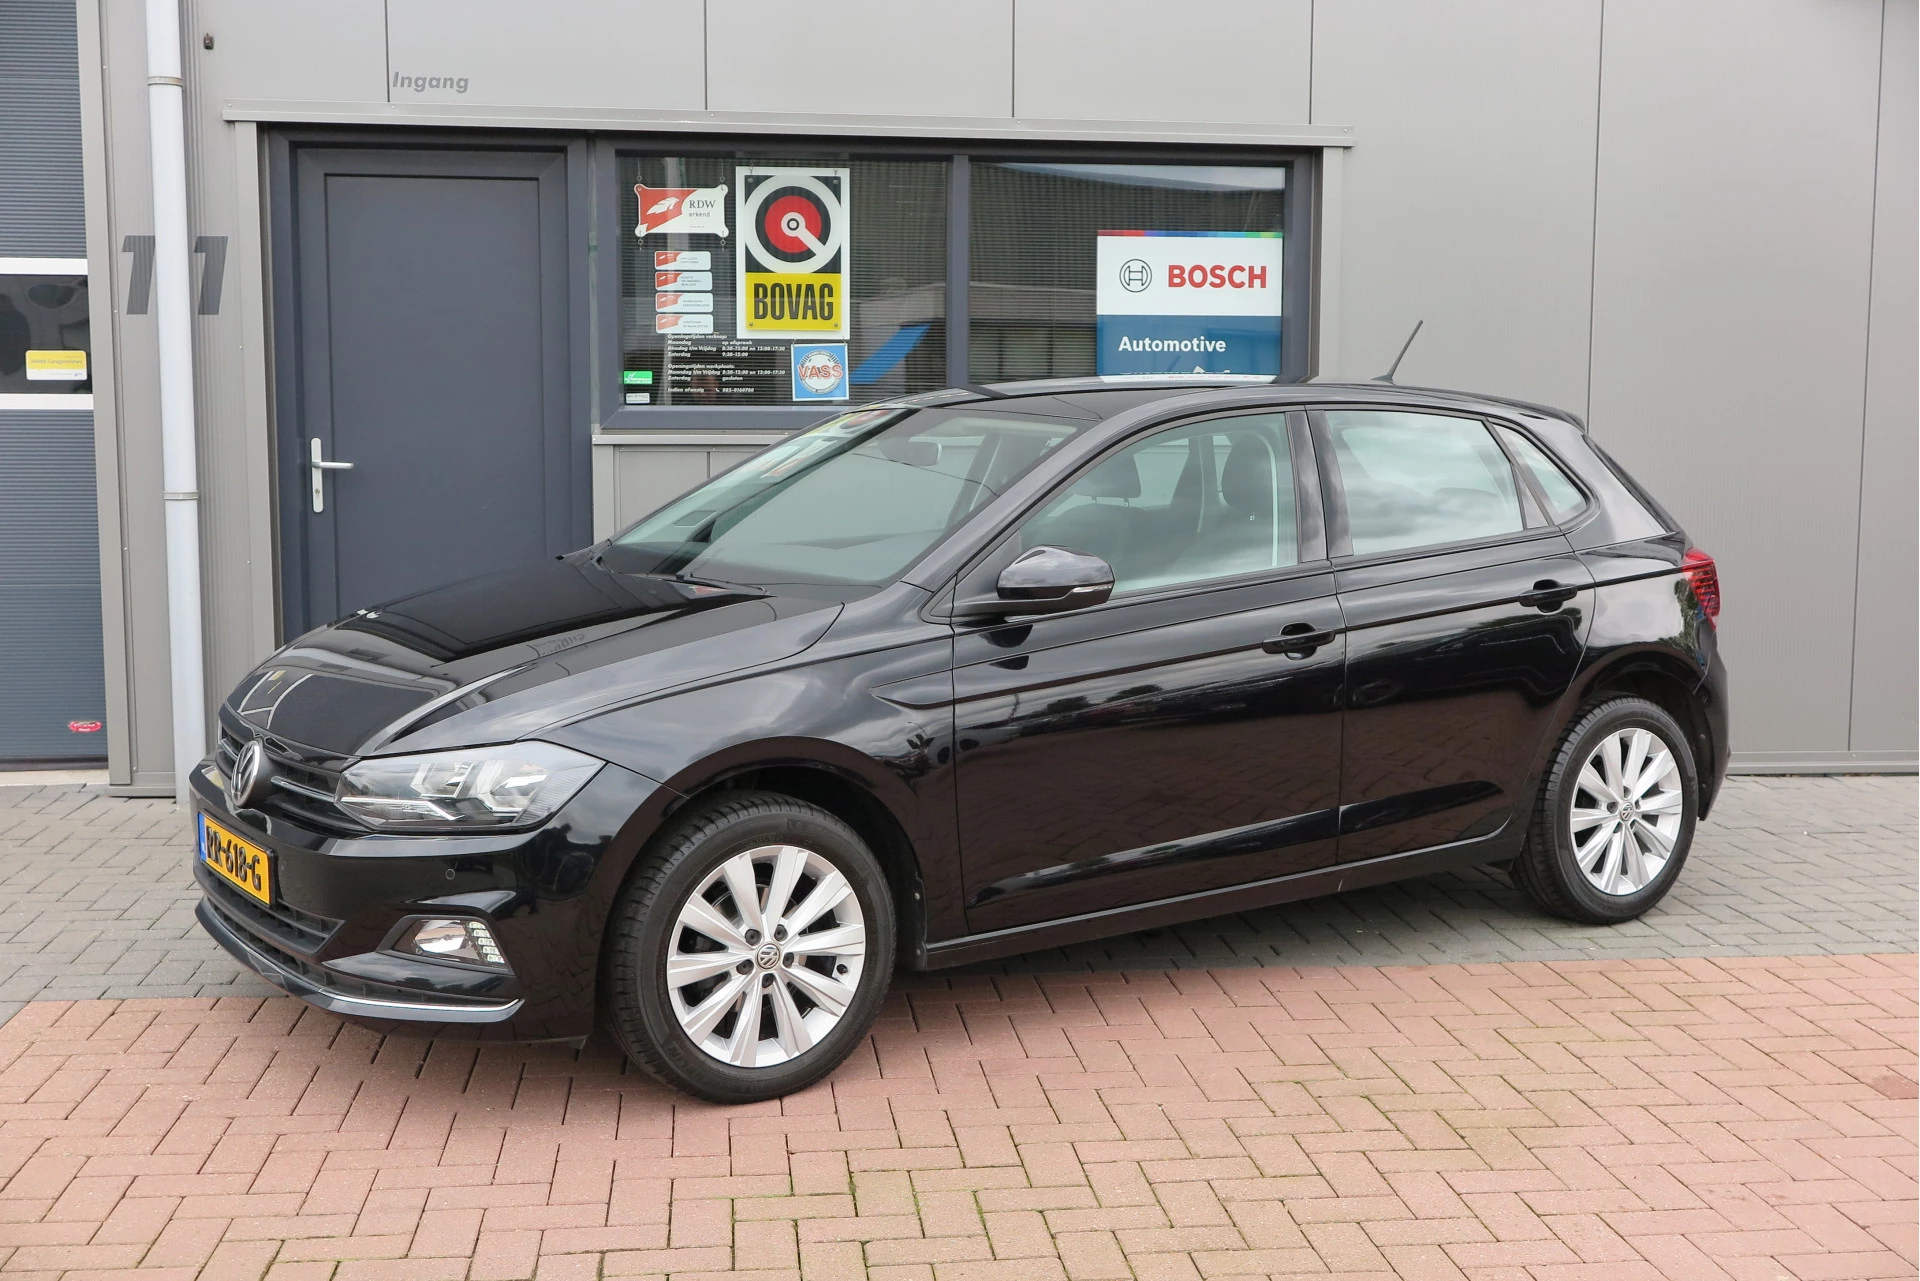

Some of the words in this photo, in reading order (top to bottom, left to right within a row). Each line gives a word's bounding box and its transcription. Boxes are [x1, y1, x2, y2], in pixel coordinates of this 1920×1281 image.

[392, 71, 469, 93] Ingang
[689, 200, 716, 209] RDW
[121, 235, 229, 316] 11
[1167, 264, 1267, 289] BOSCH
[753, 282, 834, 321] BOVAG
[1118, 336, 1227, 353] Automotive
[798, 364, 844, 379] VASS
